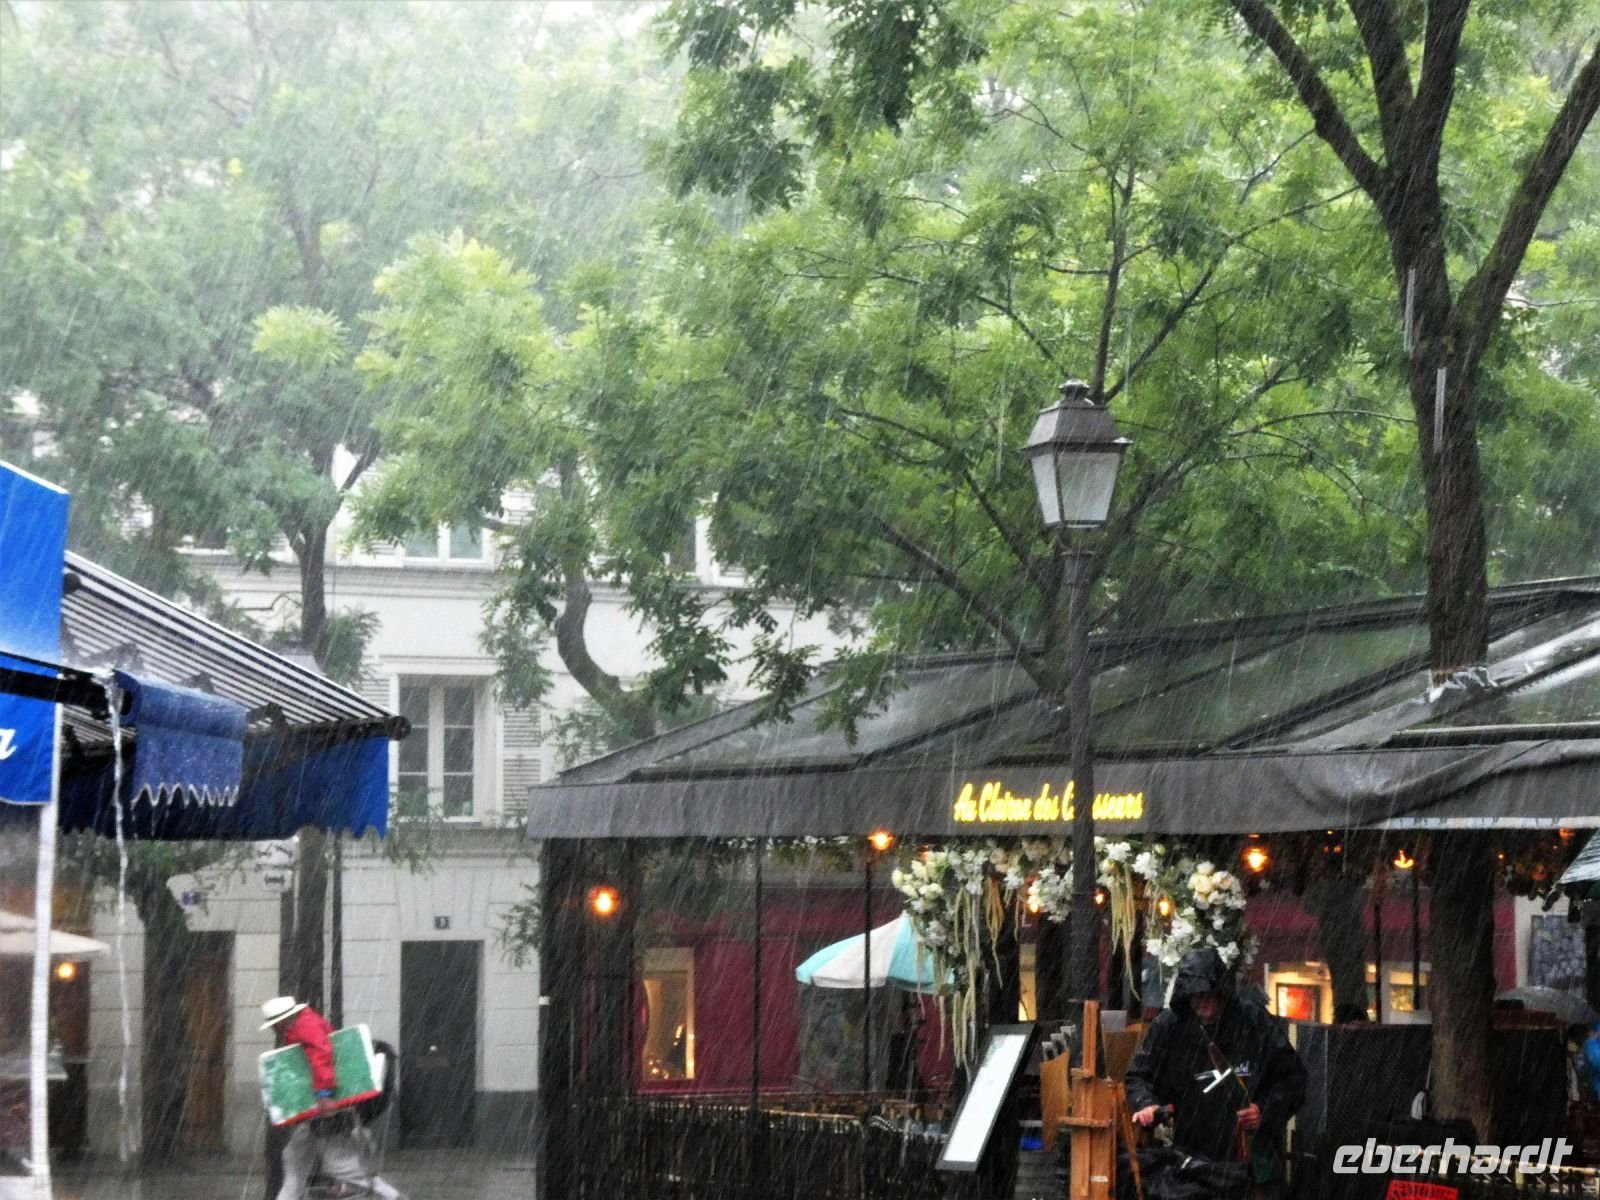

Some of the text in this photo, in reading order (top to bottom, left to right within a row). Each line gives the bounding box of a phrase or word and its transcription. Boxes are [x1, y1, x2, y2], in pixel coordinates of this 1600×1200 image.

[953, 782, 977, 821] Au
[1034, 782, 1059, 821] des
[1061, 780, 1143, 821] Csseurs
